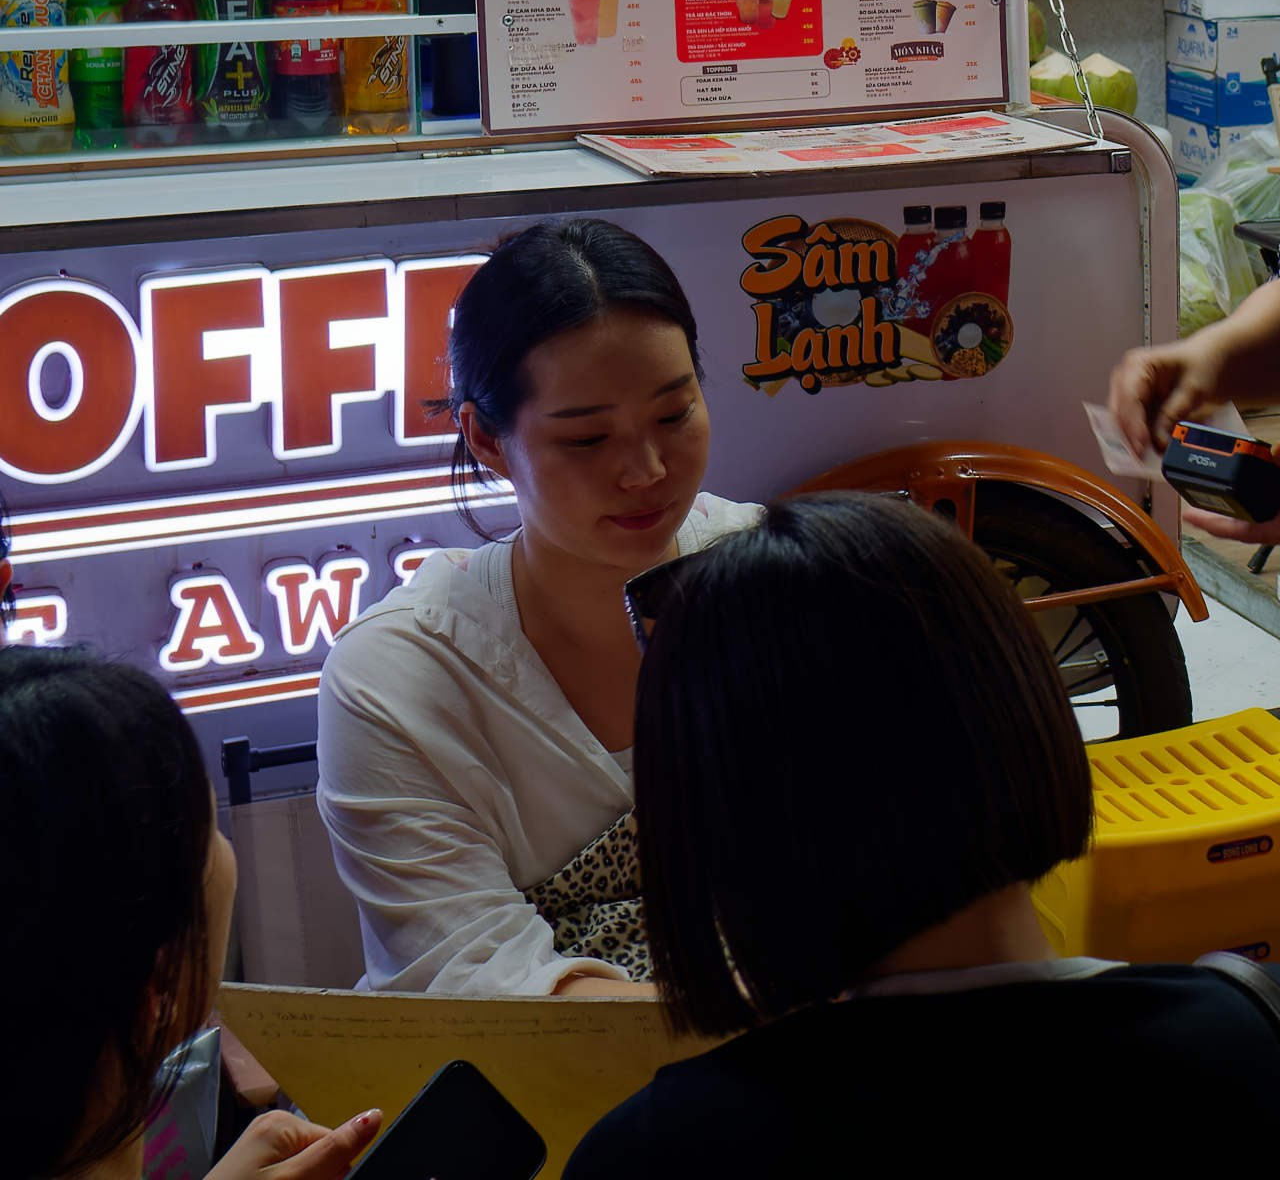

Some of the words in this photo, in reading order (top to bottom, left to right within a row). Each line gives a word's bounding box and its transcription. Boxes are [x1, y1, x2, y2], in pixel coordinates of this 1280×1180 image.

[223, 89, 258, 98] PLUS
[740, 214, 893, 297] Sâm
[742, 296, 900, 395] Lạnh
